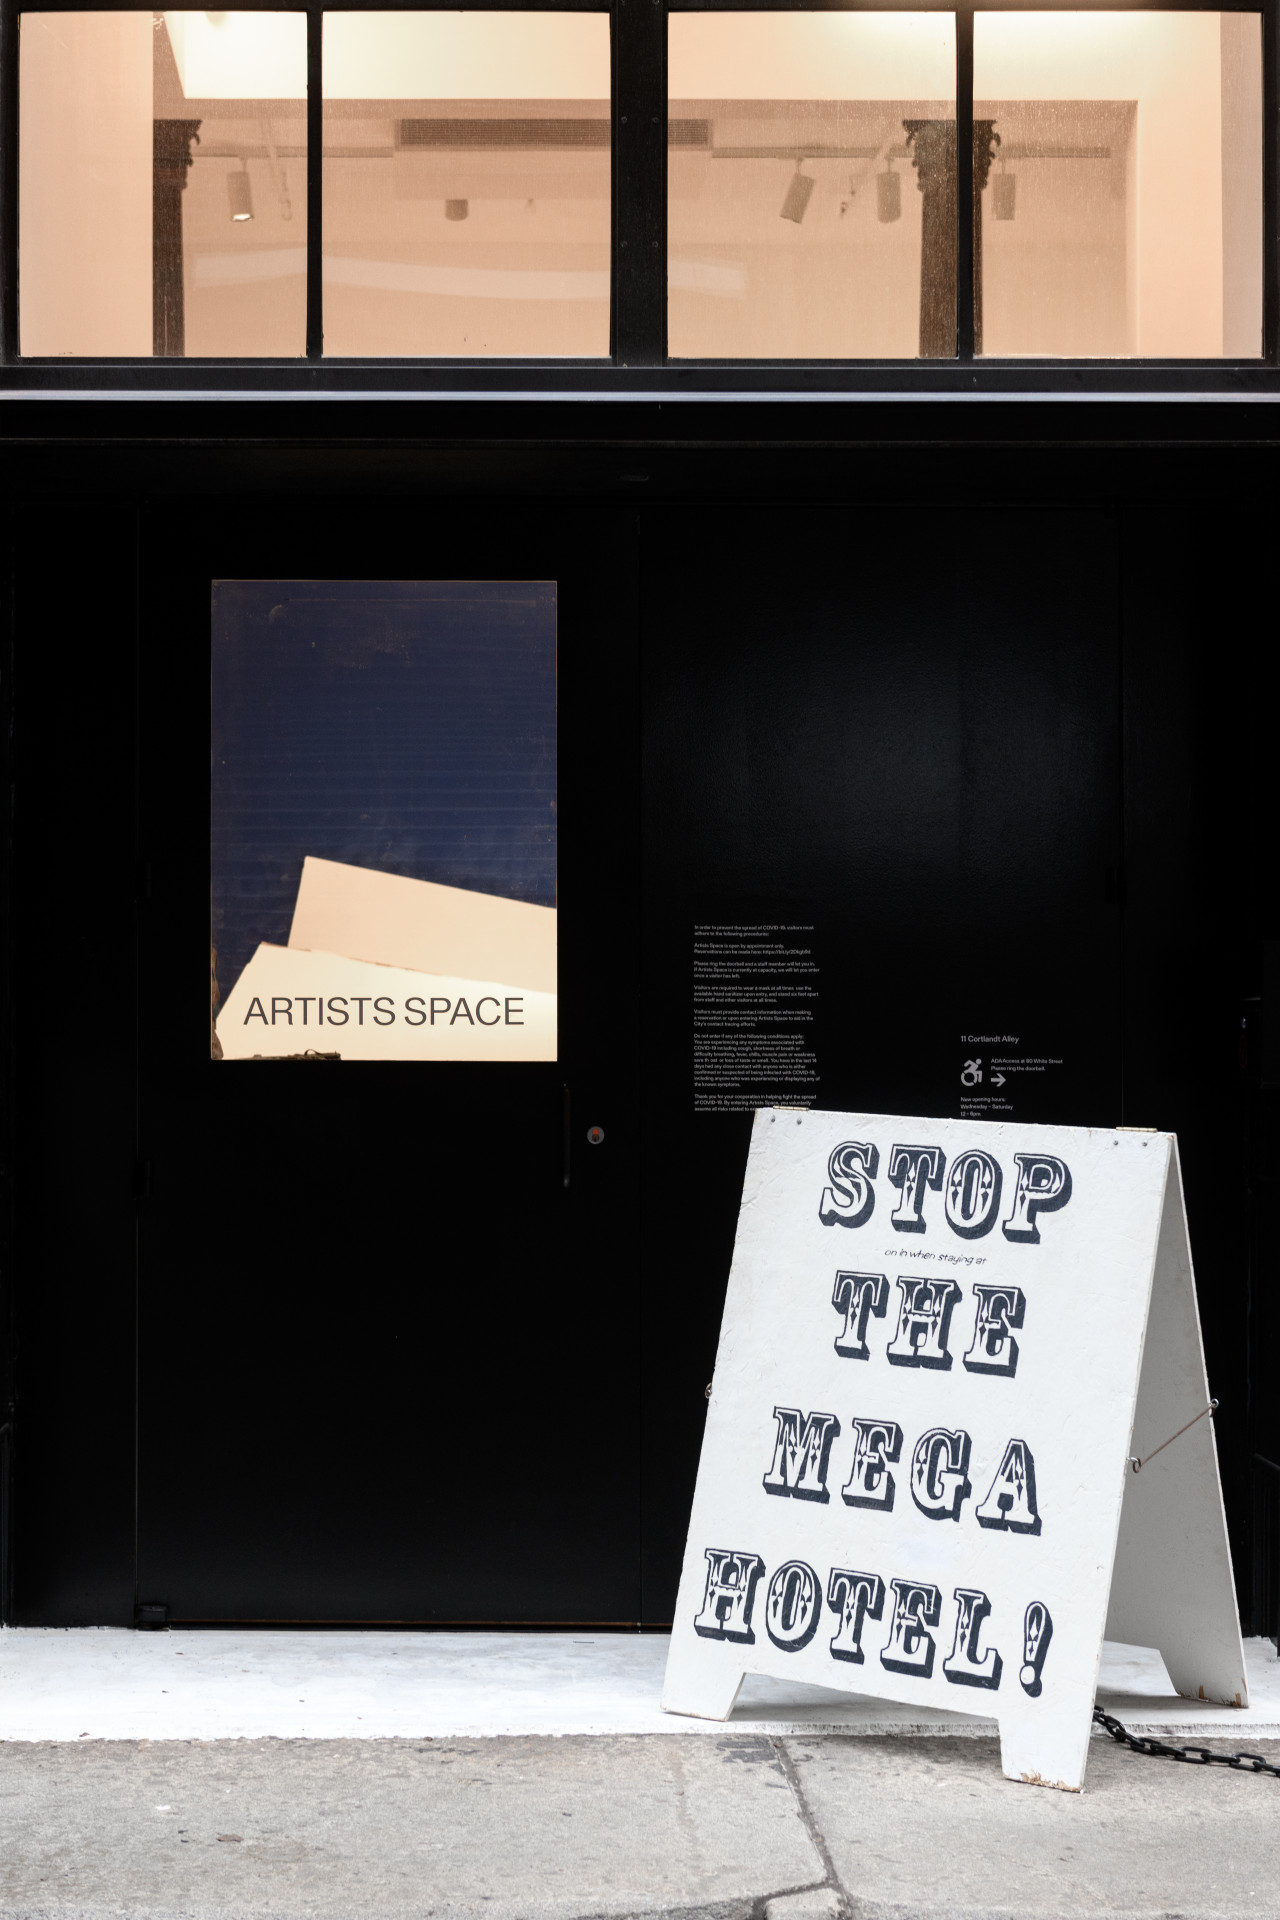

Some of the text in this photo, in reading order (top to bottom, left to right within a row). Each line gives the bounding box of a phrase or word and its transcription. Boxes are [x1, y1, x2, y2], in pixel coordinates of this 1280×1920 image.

[244, 997, 524, 1026] ARTISTS SPACE
[960, 1035, 1019, 1044] 11 Cortlandt Alley
[819, 1141, 1072, 1245] STOP
[909, 1250, 935, 1259] when
[937, 1254, 974, 1266] staying
[832, 1270, 1026, 1378] THE
[763, 1406, 1042, 1536] MEGA
[694, 1548, 1053, 1698] HOTEL!
